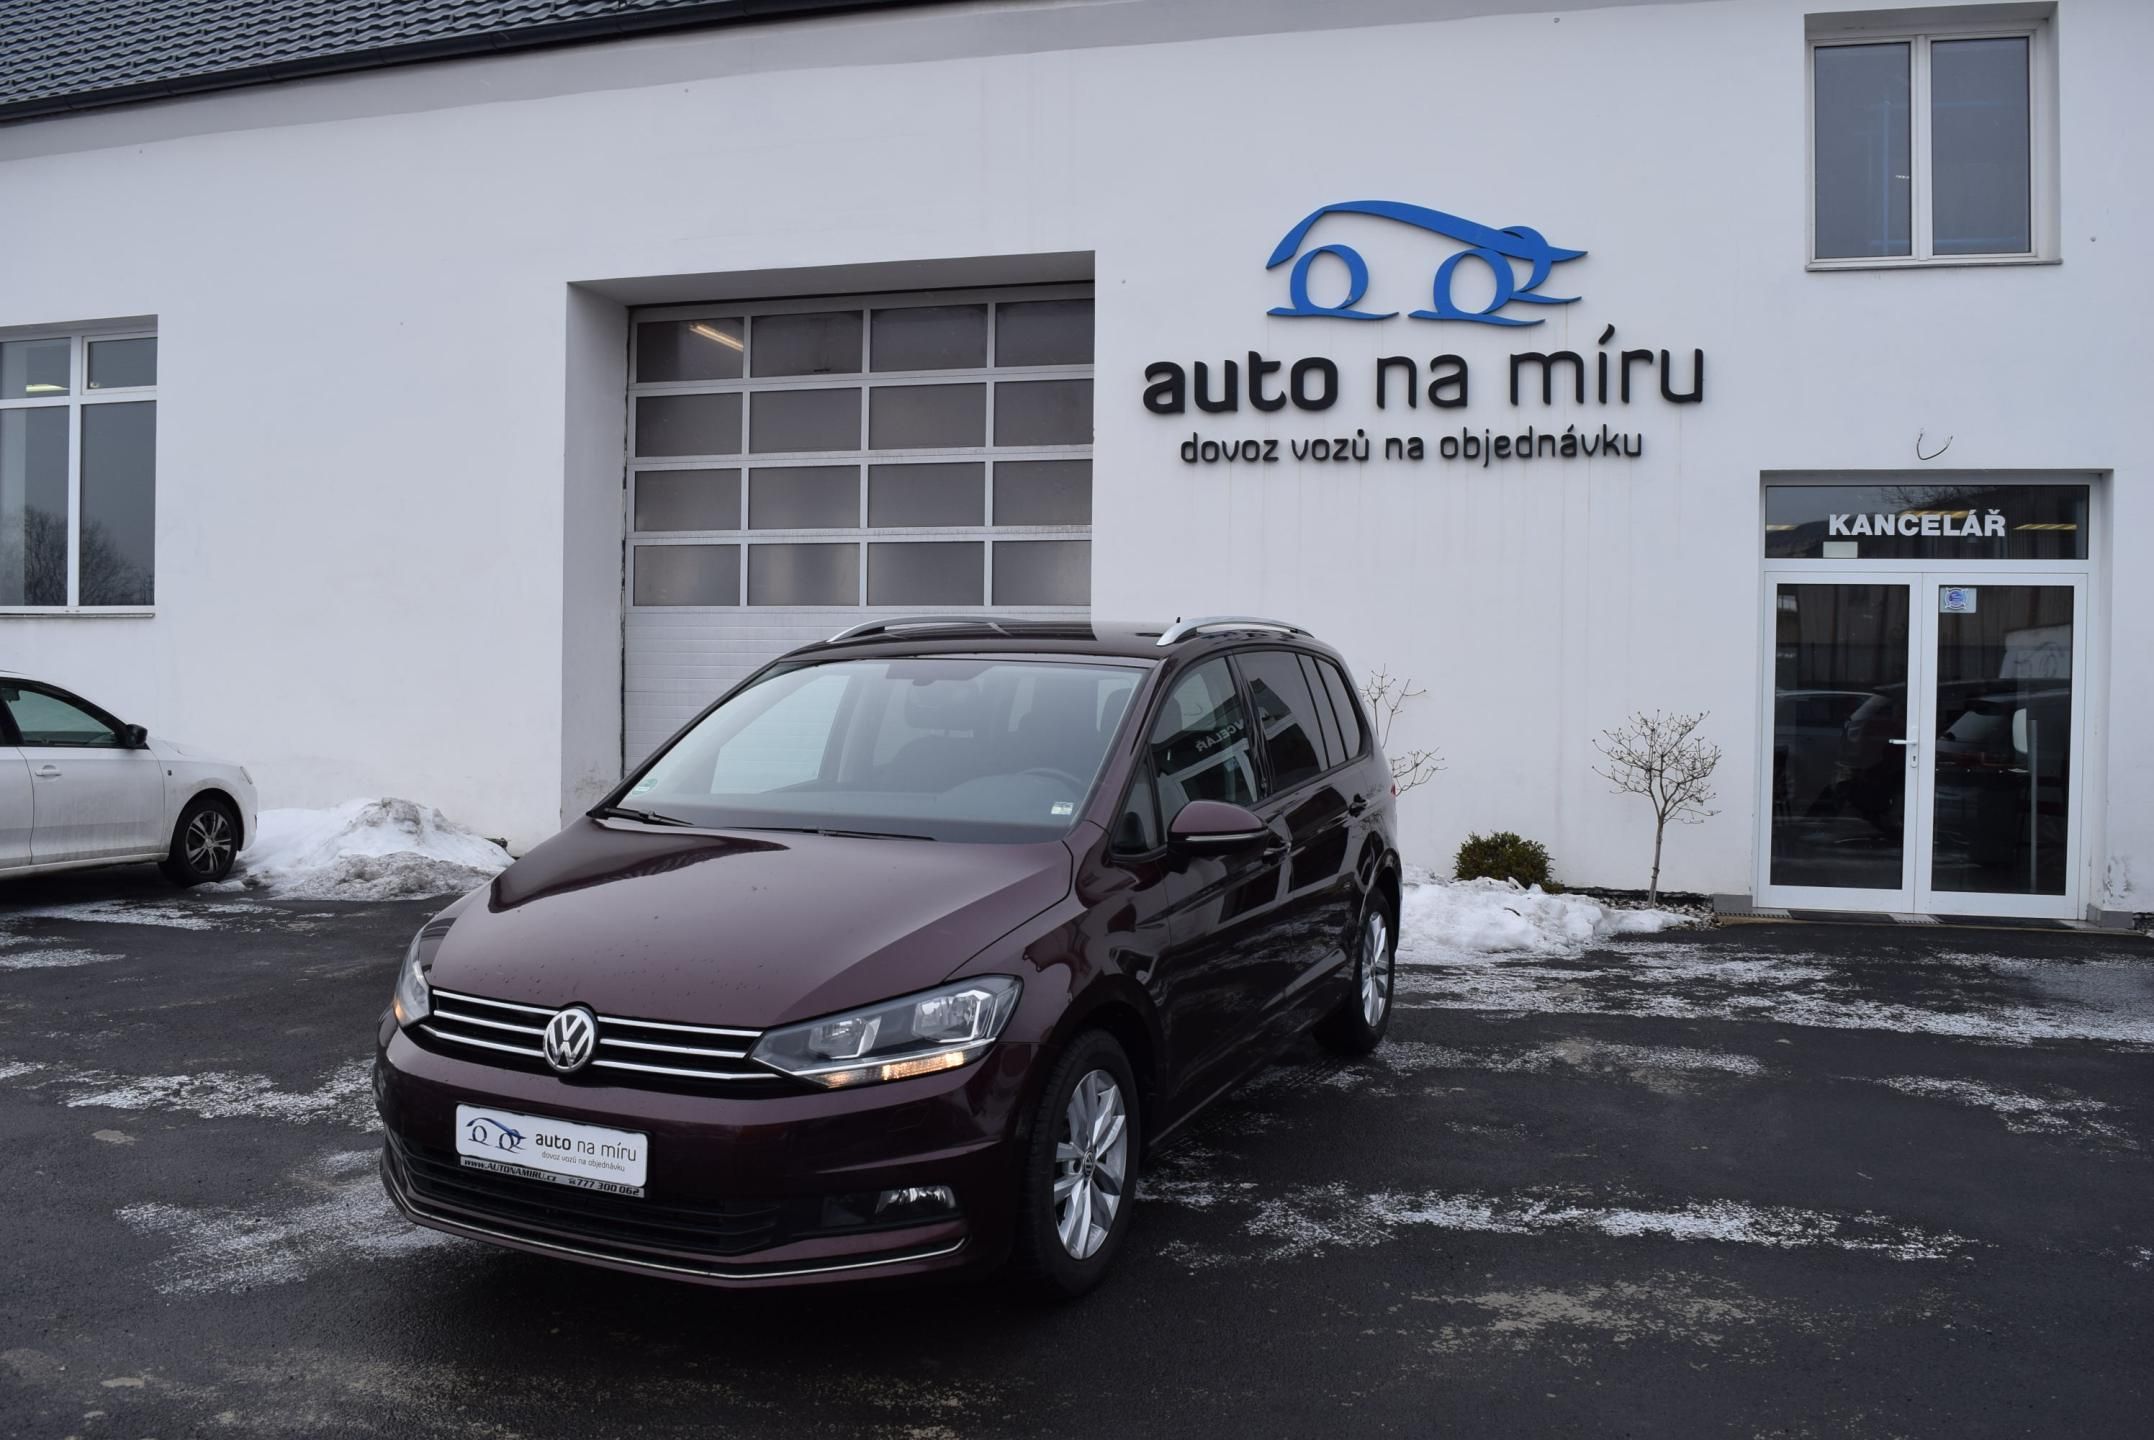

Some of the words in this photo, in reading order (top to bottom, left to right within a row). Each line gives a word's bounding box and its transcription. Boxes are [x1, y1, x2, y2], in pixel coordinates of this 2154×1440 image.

[1142, 350, 1339, 417] auto
[1376, 354, 1469, 411] na
[1509, 323, 1704, 408] míru
[1180, 431, 1280, 465] dovoz
[1291, 428, 1370, 464] vozů
[1385, 436, 1425, 462] na
[1439, 423, 1642, 469] objednávku
[1829, 508, 2007, 537] KANCELÁŘ
[535, 1132, 572, 1151] auto
[577, 1140, 596, 1155] na
[601, 1141, 637, 1162] míru
[541, 1151, 561, 1161] dovoz
[578, 1157, 587, 1166] na
[588, 1159, 626, 1172] objednávku
